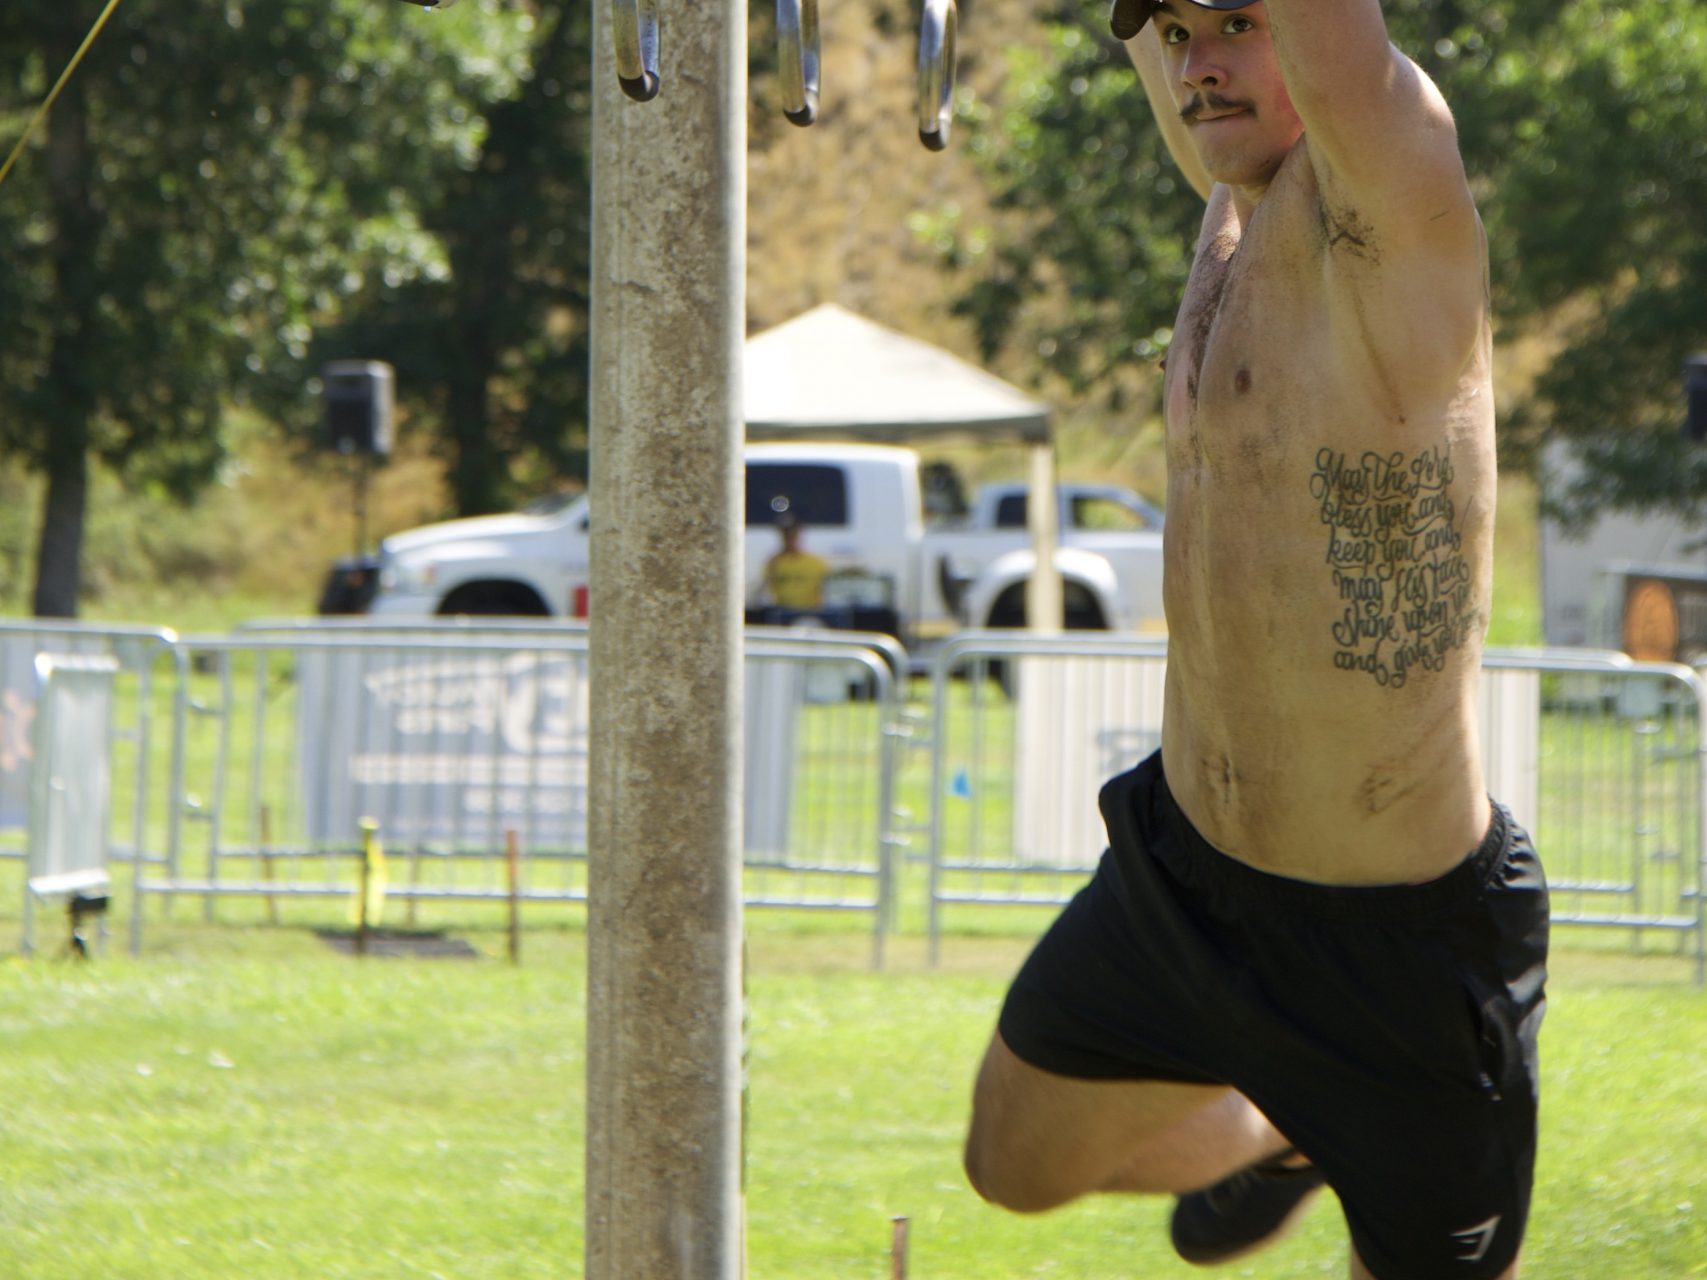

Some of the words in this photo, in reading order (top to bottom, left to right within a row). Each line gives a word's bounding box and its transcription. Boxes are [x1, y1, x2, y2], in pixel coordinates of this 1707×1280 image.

[1316, 447, 1369, 505] May
[1361, 451, 1409, 500] The
[1408, 440, 1454, 498] Lord
[1314, 484, 1373, 537] bless
[1374, 501, 1417, 543] you
[1415, 489, 1455, 530] and
[1325, 524, 1376, 574] keep
[1376, 537, 1424, 581] you
[1424, 523, 1461, 552] and
[1402, 601, 1447, 644] upon
[1334, 637, 1388, 686] and
[1391, 639, 1429, 689] give
